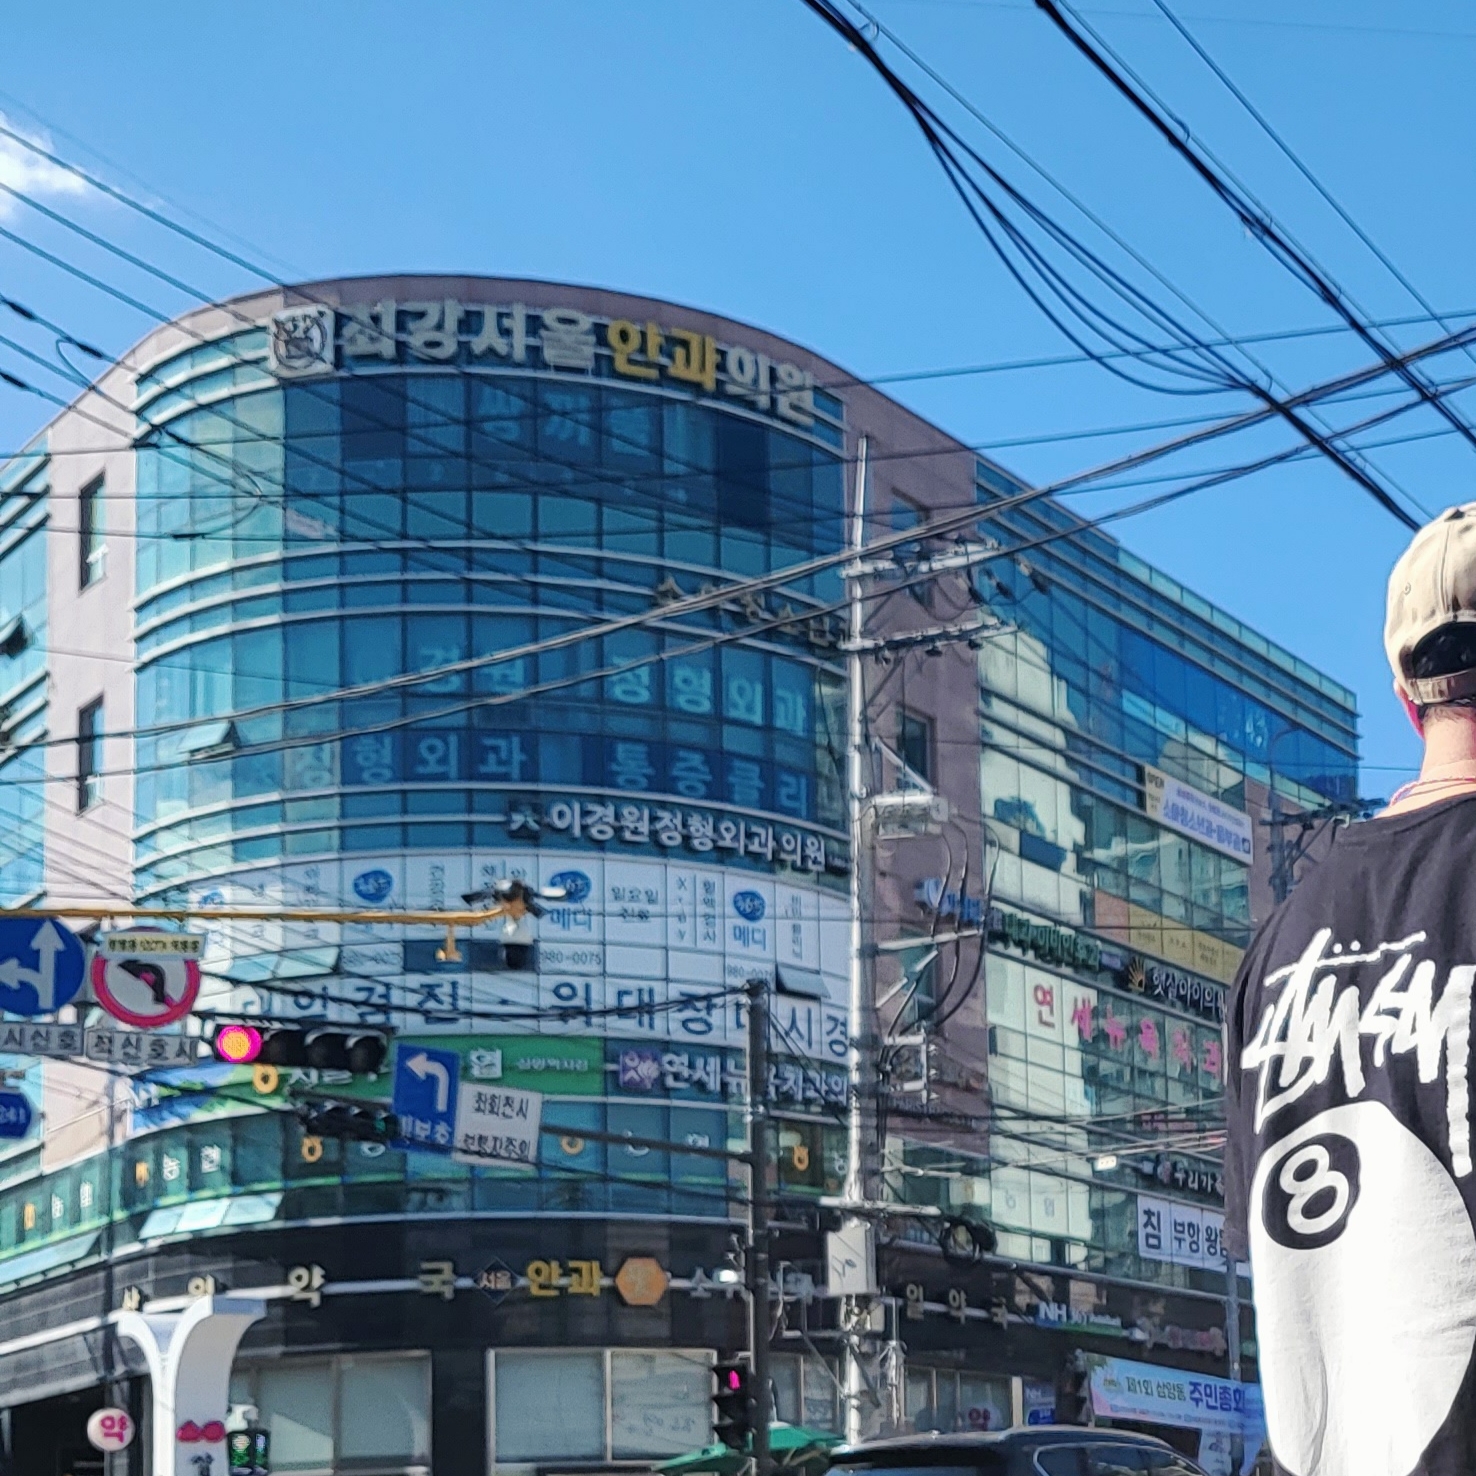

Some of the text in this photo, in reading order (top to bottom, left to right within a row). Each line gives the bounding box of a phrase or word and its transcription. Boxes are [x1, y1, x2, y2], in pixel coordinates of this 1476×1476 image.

[551, 800, 826, 871] 이경원정형외과의원
[733, 925, 767, 951] 메디
[1278, 1142, 1351, 1235] 8
[1142, 1207, 1162, 1251] 침
[1173, 1217, 1201, 1254] 부항
[526, 1259, 604, 1297] 안과
[100, 1413, 129, 1444] 약
